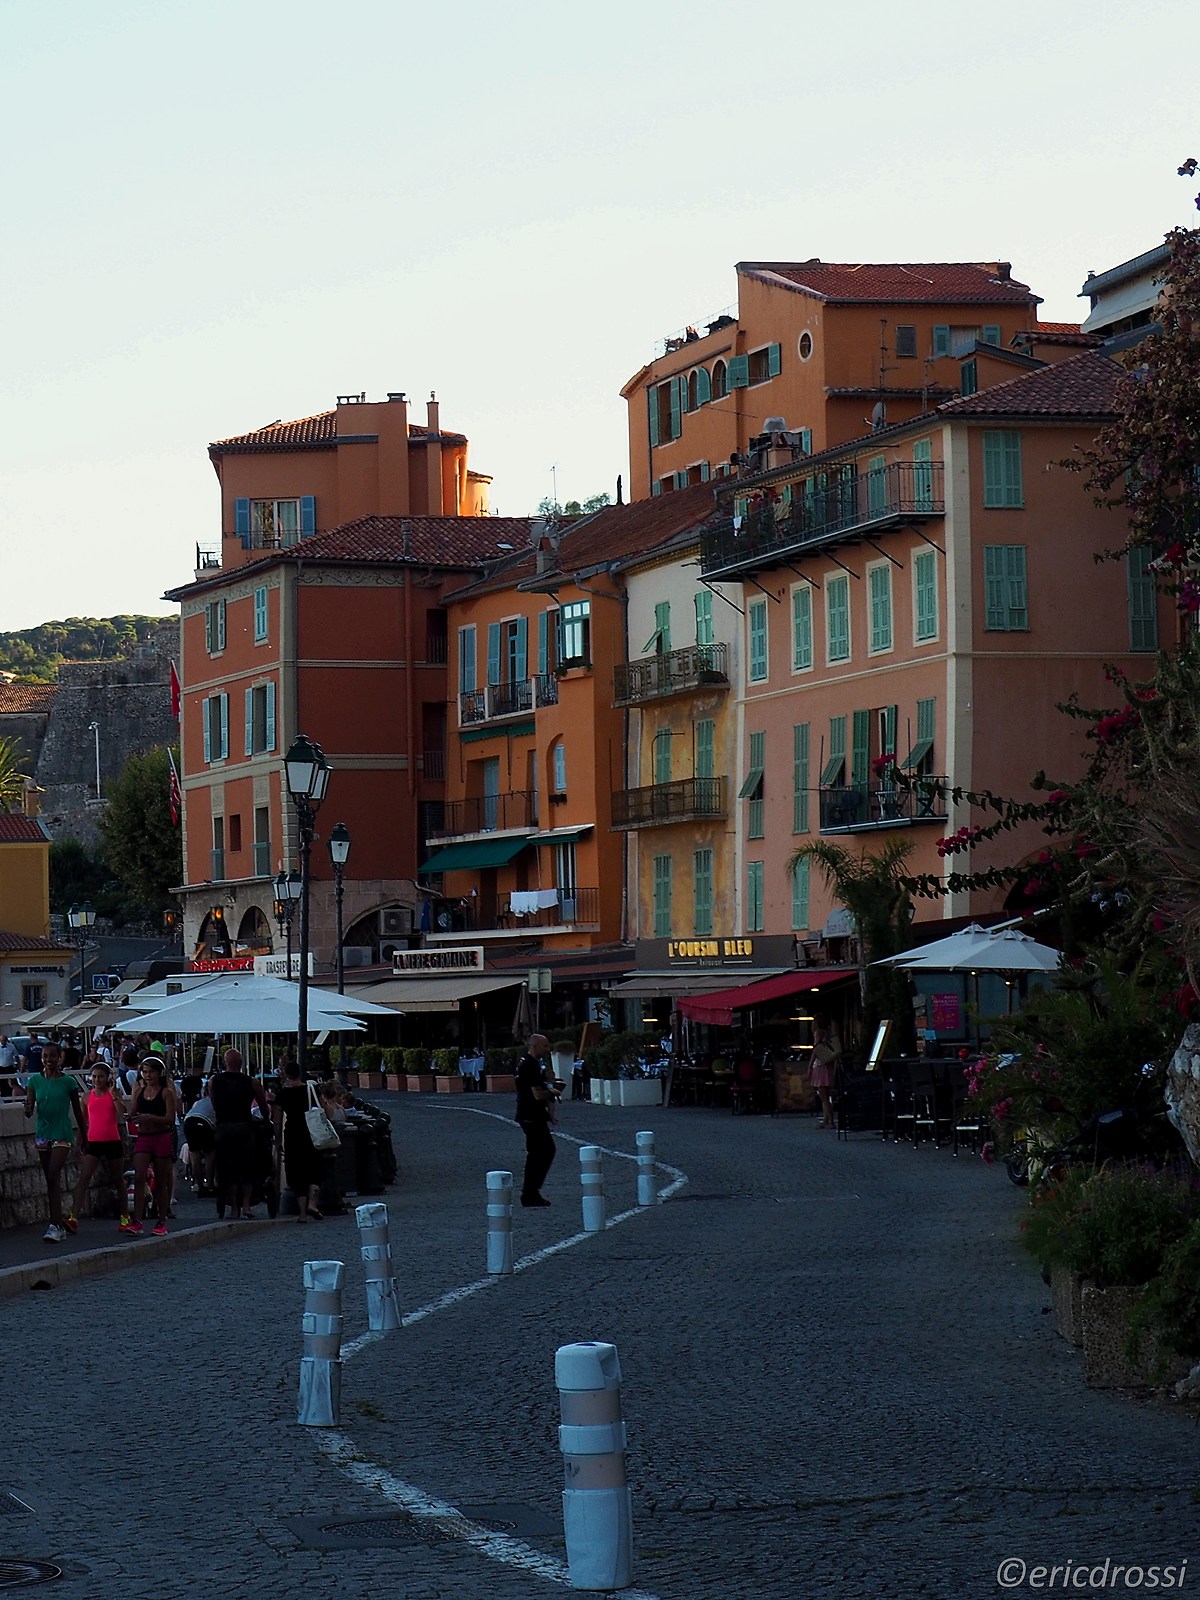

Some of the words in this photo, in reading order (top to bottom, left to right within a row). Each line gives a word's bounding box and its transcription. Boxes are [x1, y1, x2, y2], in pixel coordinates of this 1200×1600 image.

[668, 941, 719, 957] L'OURSIN
[724, 940, 752, 956] BLEU
[192, 957, 254, 972] NEWPORT
[430, 951, 478, 968] GERMAINE
